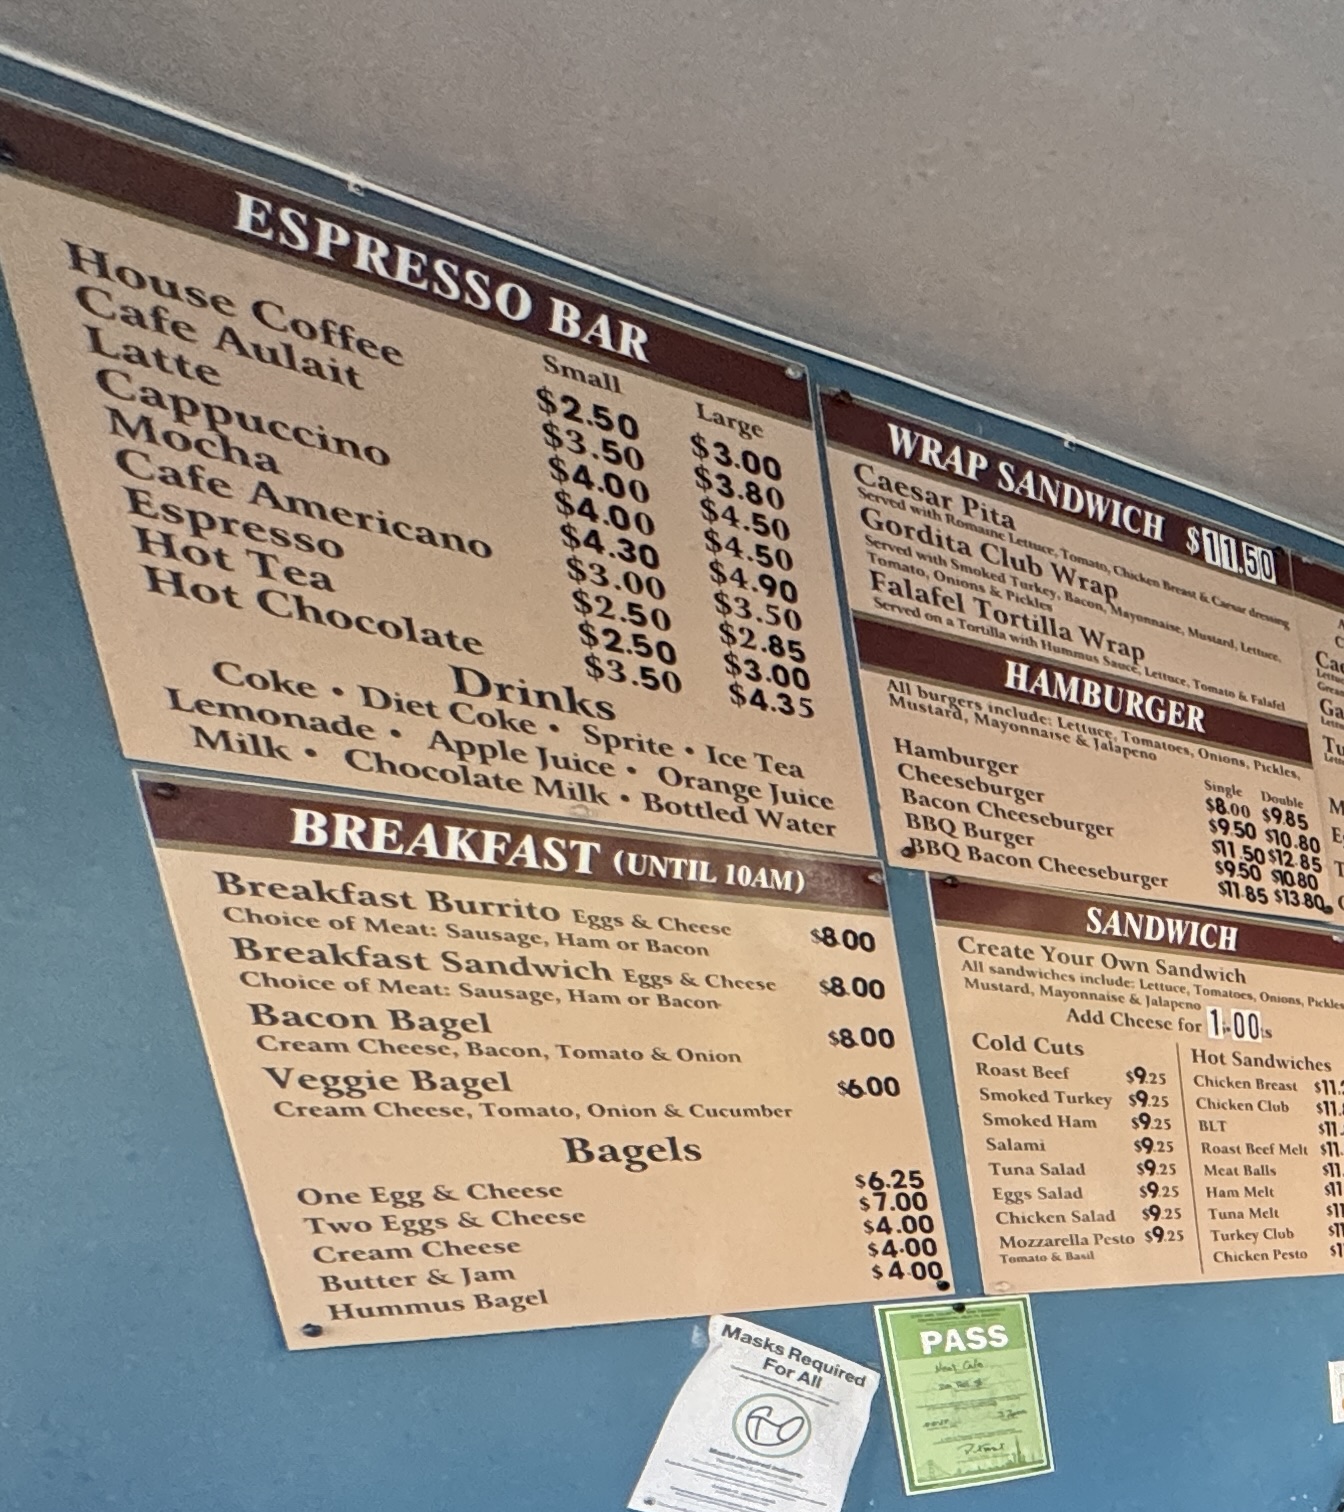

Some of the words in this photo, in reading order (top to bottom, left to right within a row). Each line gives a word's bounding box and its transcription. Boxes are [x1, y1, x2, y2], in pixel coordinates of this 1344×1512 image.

[233, 191, 532, 321] ESPRESSO
[548, 296, 649, 363] BAR
[64, 240, 236, 318] House
[251, 300, 404, 367] Coffee
[536, 385, 640, 441] $2.50
[690, 432, 782, 481] $3.00
[75, 286, 197, 343] Cafe
[214, 326, 365, 391] Aulait
[542, 420, 645, 471] $3.50
[694, 463, 785, 510] $3.80
[542, 354, 622, 394] Small
[695, 402, 764, 440] Large
[95, 368, 391, 466] Cappuccino
[554, 489, 655, 536] $4.00
[703, 527, 794, 571] $4.50
[853, 463, 953, 511] Caesar
[961, 495, 1016, 531] Pita
[887, 423, 988, 481] WRAP
[997, 461, 1165, 542] SANDWICH
[1186, 526, 1275, 583] $11.50
[104, 406, 282, 475] Mocha
[559, 522, 660, 570] $4.30
[708, 558, 798, 604] $4.90
[122, 486, 345, 559] Espresso
[572, 588, 671, 632] $2.50
[718, 620, 806, 664] $2.85
[860, 506, 972, 558] Gordita
[979, 542, 1043, 577] Club
[1050, 561, 1119, 604] Wrap
[142, 564, 243, 610] Hot
[256, 589, 484, 656] Chocolate
[584, 652, 682, 694] $3.50
[728, 681, 815, 719] $4.35
[869, 569, 965, 614] Falafel
[972, 596, 1073, 642] Tortilla
[1078, 625, 1145, 666] Wrap
[448, 664, 616, 721] Drinks
[888, 692, 969, 723] Mustard,
[974, 711, 1071, 744] Mayonnaise
[1075, 734, 1090, 748] &
[1093, 737, 1157, 761] Jalapeno
[1004, 659, 1206, 733] HAMBURGER
[165, 687, 376, 741] Lemonade
[427, 729, 528, 766] Apple
[535, 746, 616, 778] Juice
[657, 766, 762, 804] Orange
[768, 782, 834, 811] Juice
[893, 736, 1019, 777] Hamburger
[1205, 796, 1251, 819] $8.00
[1261, 806, 1309, 831] $9.85
[290, 808, 601, 875] BREAKFAST
[613, 849, 718, 883] (UNTIL
[725, 863, 805, 894] 10AM)
[901, 787, 971, 814] Bacon
[976, 800, 1114, 838] Cheeseburger
[1211, 839, 1266, 866] $11.50
[1267, 848, 1323, 874] $12.85
[213, 870, 417, 910] Breakfast
[426, 890, 561, 922] Burrito
[572, 908, 624, 931] Eggs
[631, 914, 652, 930] &
[657, 916, 732, 936] Cheese
[810, 926, 876, 953] $8.00
[222, 906, 320, 929] Choice
[328, 915, 356, 931] of
[363, 917, 437, 937] Meat:
[445, 923, 549, 949] Sausage,
[555, 931, 610, 949] Ham
[616, 940, 640, 951] or
[645, 938, 709, 956] Bacon
[1086, 906, 1238, 952] SANDWICH
[957, 935, 1035, 961] Create
[1040, 945, 1095, 967] Your
[1101, 952, 1150, 974] Own
[1155, 958, 1247, 984] Sandwich
[247, 1003, 378, 1030] Bacon
[387, 1009, 492, 1041] Bagel
[828, 1026, 895, 1049] $8.00
[972, 1032, 1027, 1053] Cold
[1033, 1036, 1085, 1057] Cuts
[1066, 1007, 1105, 1025] Add
[1110, 1011, 1173, 1031] Cheese
[1178, 1017, 1203, 1033] for
[1191, 1048, 1227, 1066] Hot
[1231, 1051, 1332, 1072] Sandwiches
[979, 1087, 1050, 1103] Smoked
[1053, 1090, 1112, 1110] Turkey
[1128, 1089, 1169, 1108] $9.25
[1198, 1119, 1227, 1132] BLT
[561, 1135, 702, 1173] Bagels
[1200, 1142, 1242, 1155] Roast
[1245, 1142, 1275, 1155] Beef
[1278, 1143, 1309, 1156] Melt
[297, 1188, 360, 1206] One
[369, 1186, 425, 1209] Egg
[432, 1184, 460, 1202] &
[466, 1183, 563, 1200] Cheese
[855, 1169, 925, 1191] $6.25
[319, 1275, 417, 1292] Butter
[426, 1268, 454, 1286] &
[460, 1267, 516, 1287] Jam
[867, 1237, 938, 1259] $4.00
[999, 1254, 1048, 1264] Tomato
[1050, 1251, 1062, 1262] &
[1065, 1250, 1095, 1261] Basil
[721, 1324, 785, 1357] Masks
[788, 1344, 867, 1389] Required
[920, 1324, 1009, 1355] PASS
[762, 1359, 797, 1380] For
[797, 1367, 823, 1390] All
